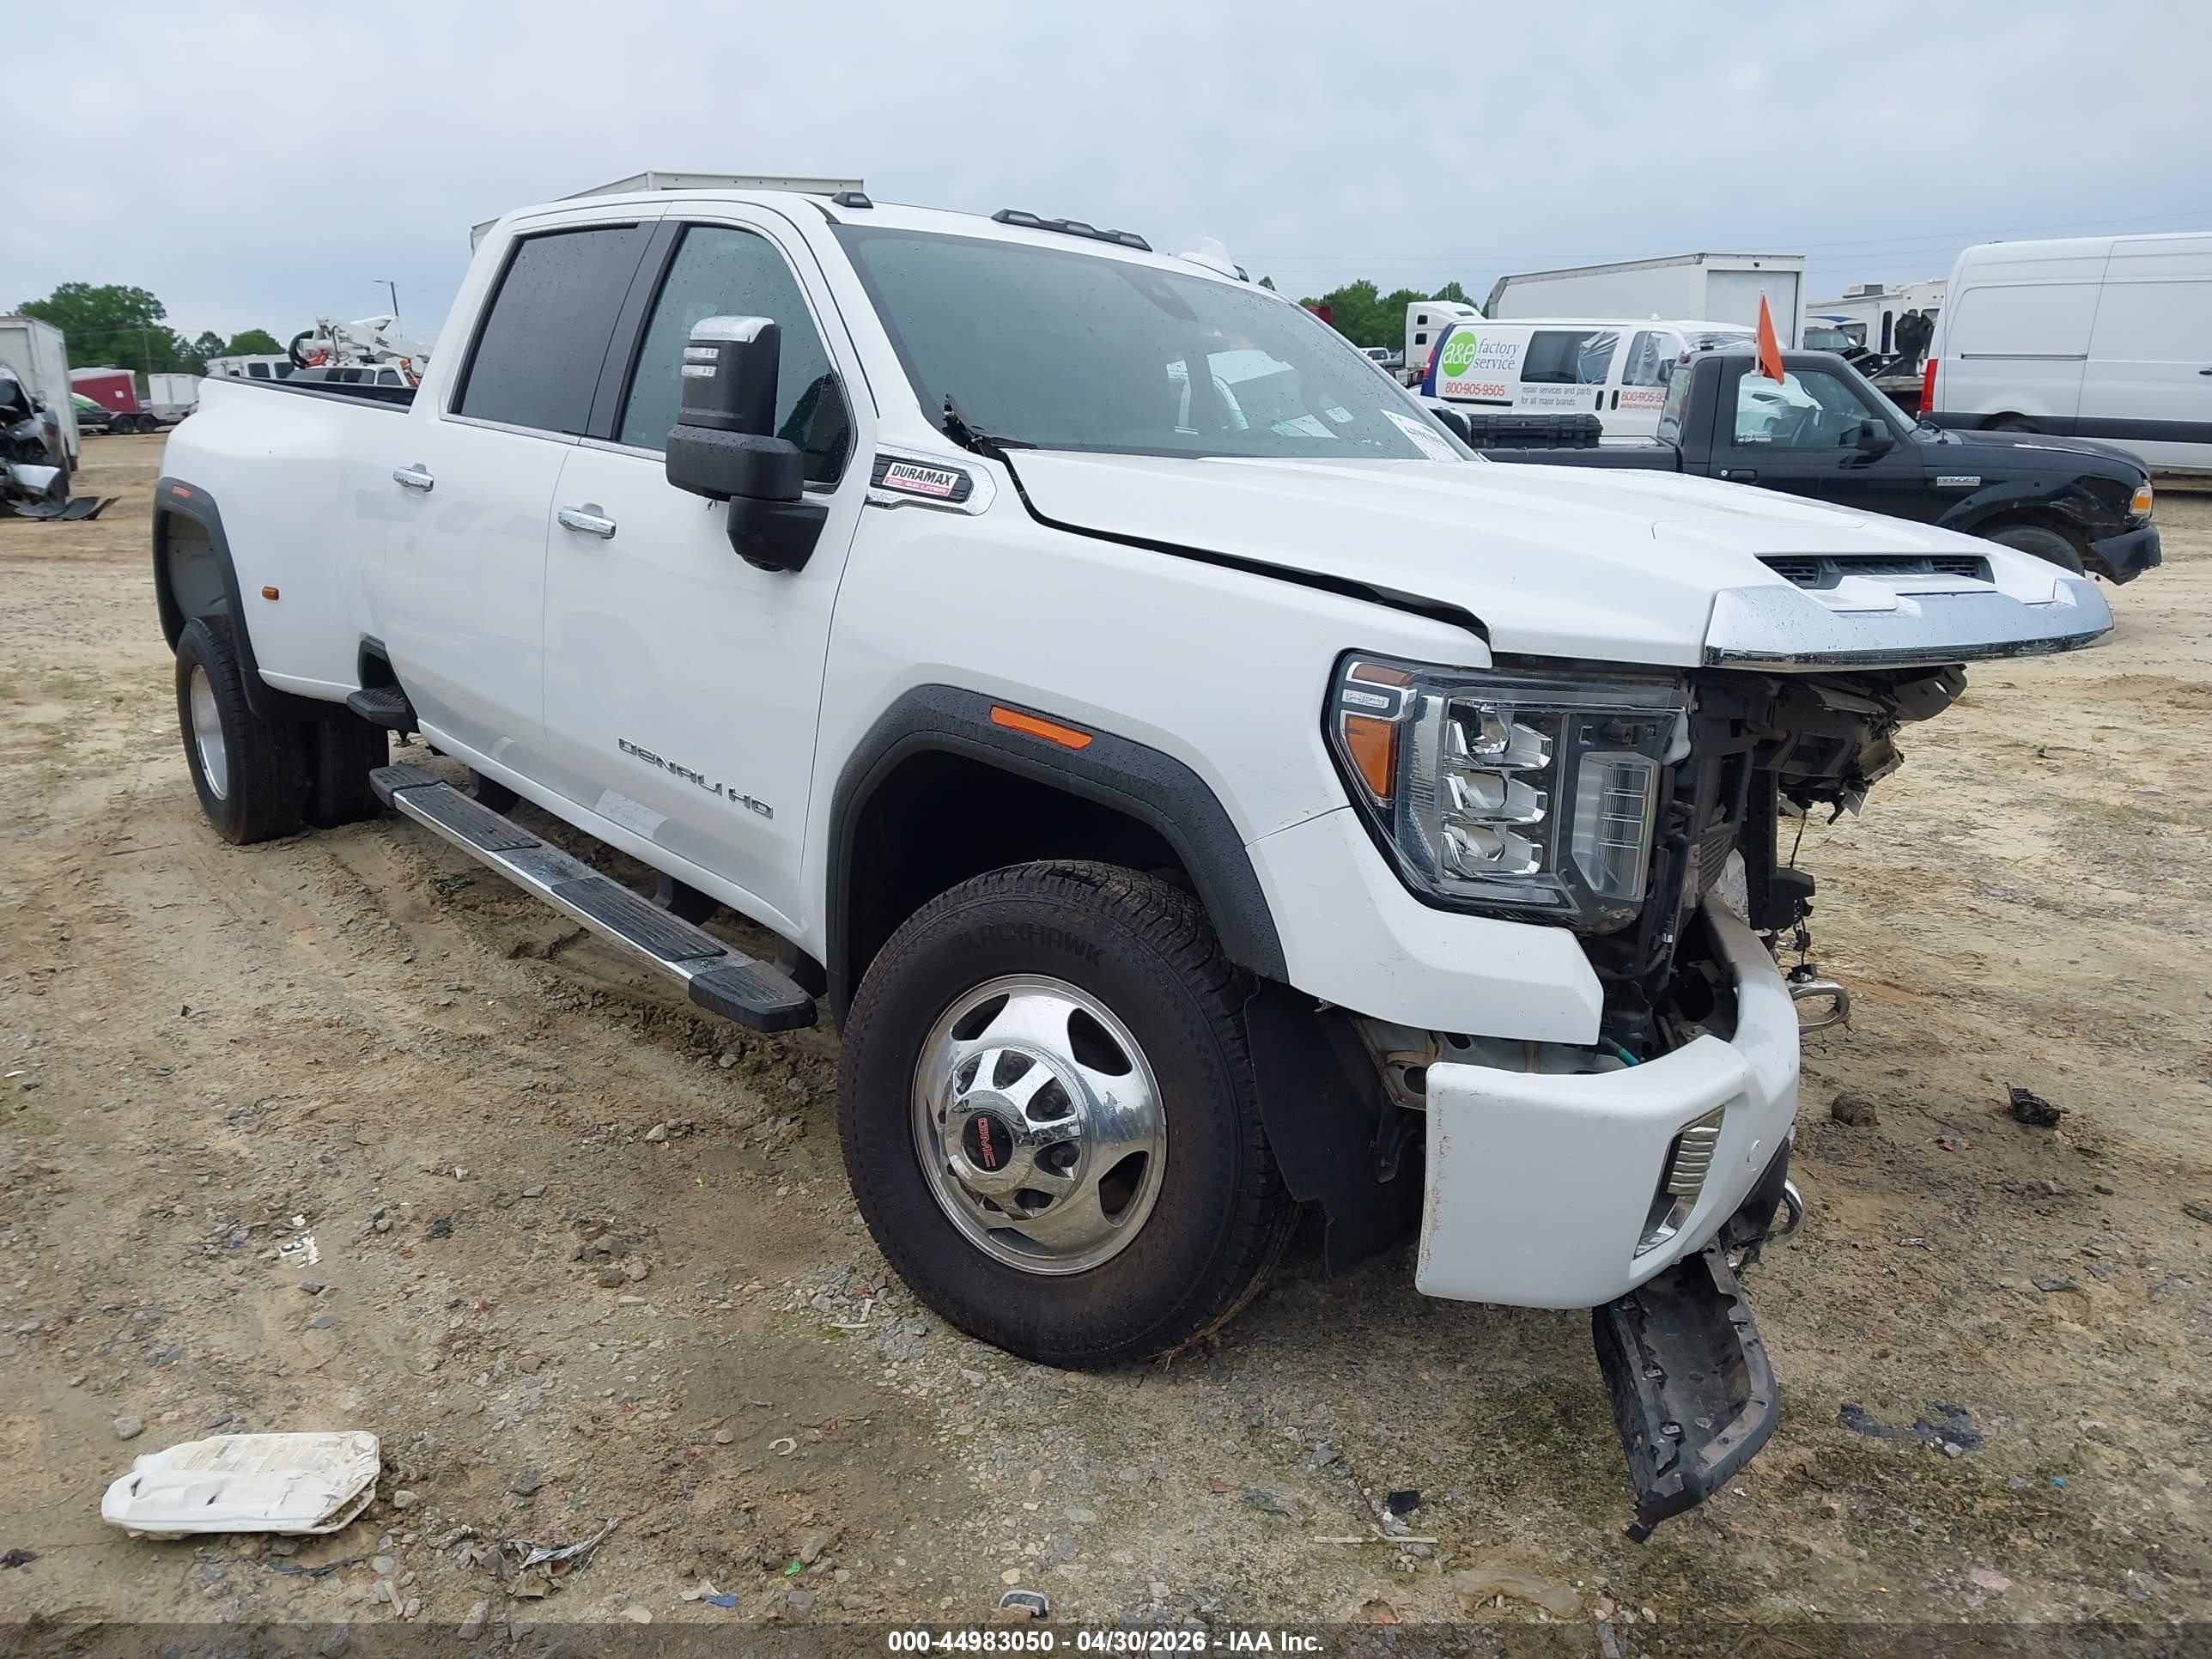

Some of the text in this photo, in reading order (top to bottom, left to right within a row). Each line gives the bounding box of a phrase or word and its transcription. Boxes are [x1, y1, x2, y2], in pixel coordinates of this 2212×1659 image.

[1443, 343, 1475, 365] a&e
[1478, 338, 1520, 359] factory
[1473, 355, 1516, 370] service
[1445, 381, 1506, 397] 800-905-9505
[1539, 386, 1562, 395] services
[1564, 386, 1574, 395] and
[1576, 387, 1592, 397] parts
[1539, 398, 1555, 407] major
[1556, 397, 1577, 406] brands
[891, 465, 954, 487] DURAMAX
[618, 737, 774, 820] DENALI HD
[978, 1117, 996, 1168] GMC
